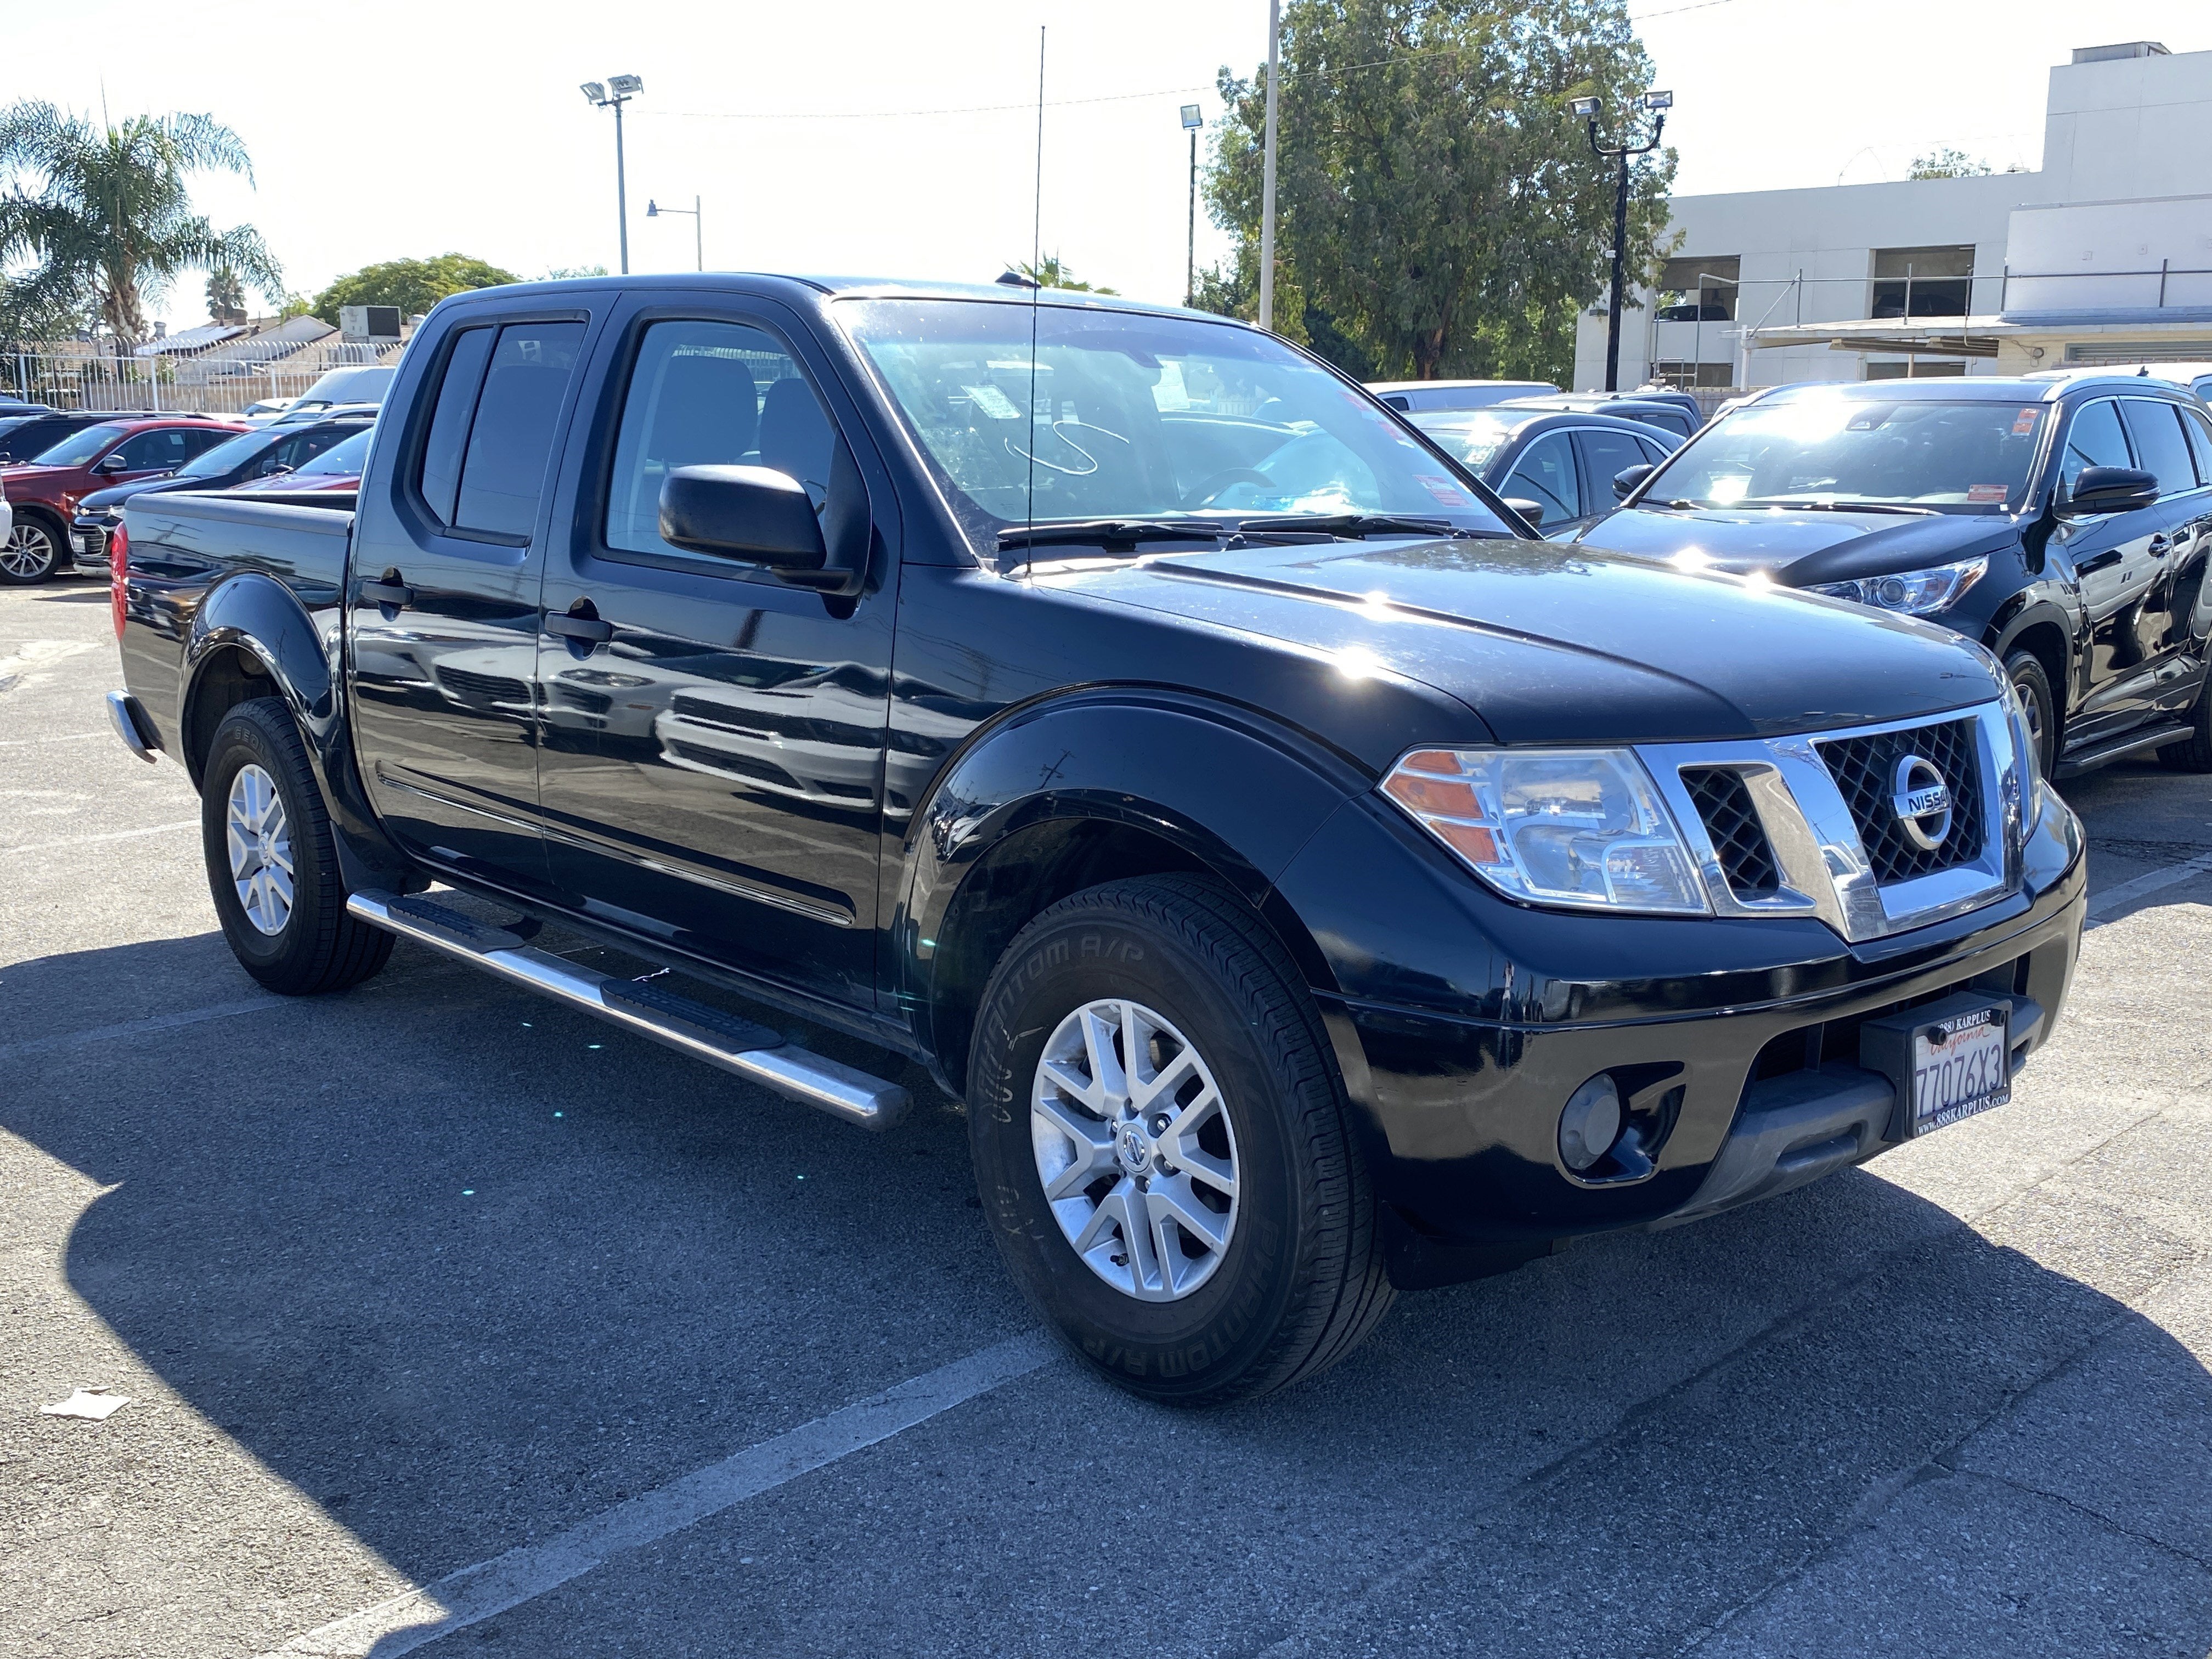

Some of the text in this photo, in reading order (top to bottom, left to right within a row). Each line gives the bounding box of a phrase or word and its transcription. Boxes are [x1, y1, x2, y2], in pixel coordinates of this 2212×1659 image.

[1080, 933, 1146, 964] A/P
[1956, 1009, 1991, 1030] KARPLUS
[1916, 1044, 2001, 1118] 77076X3
